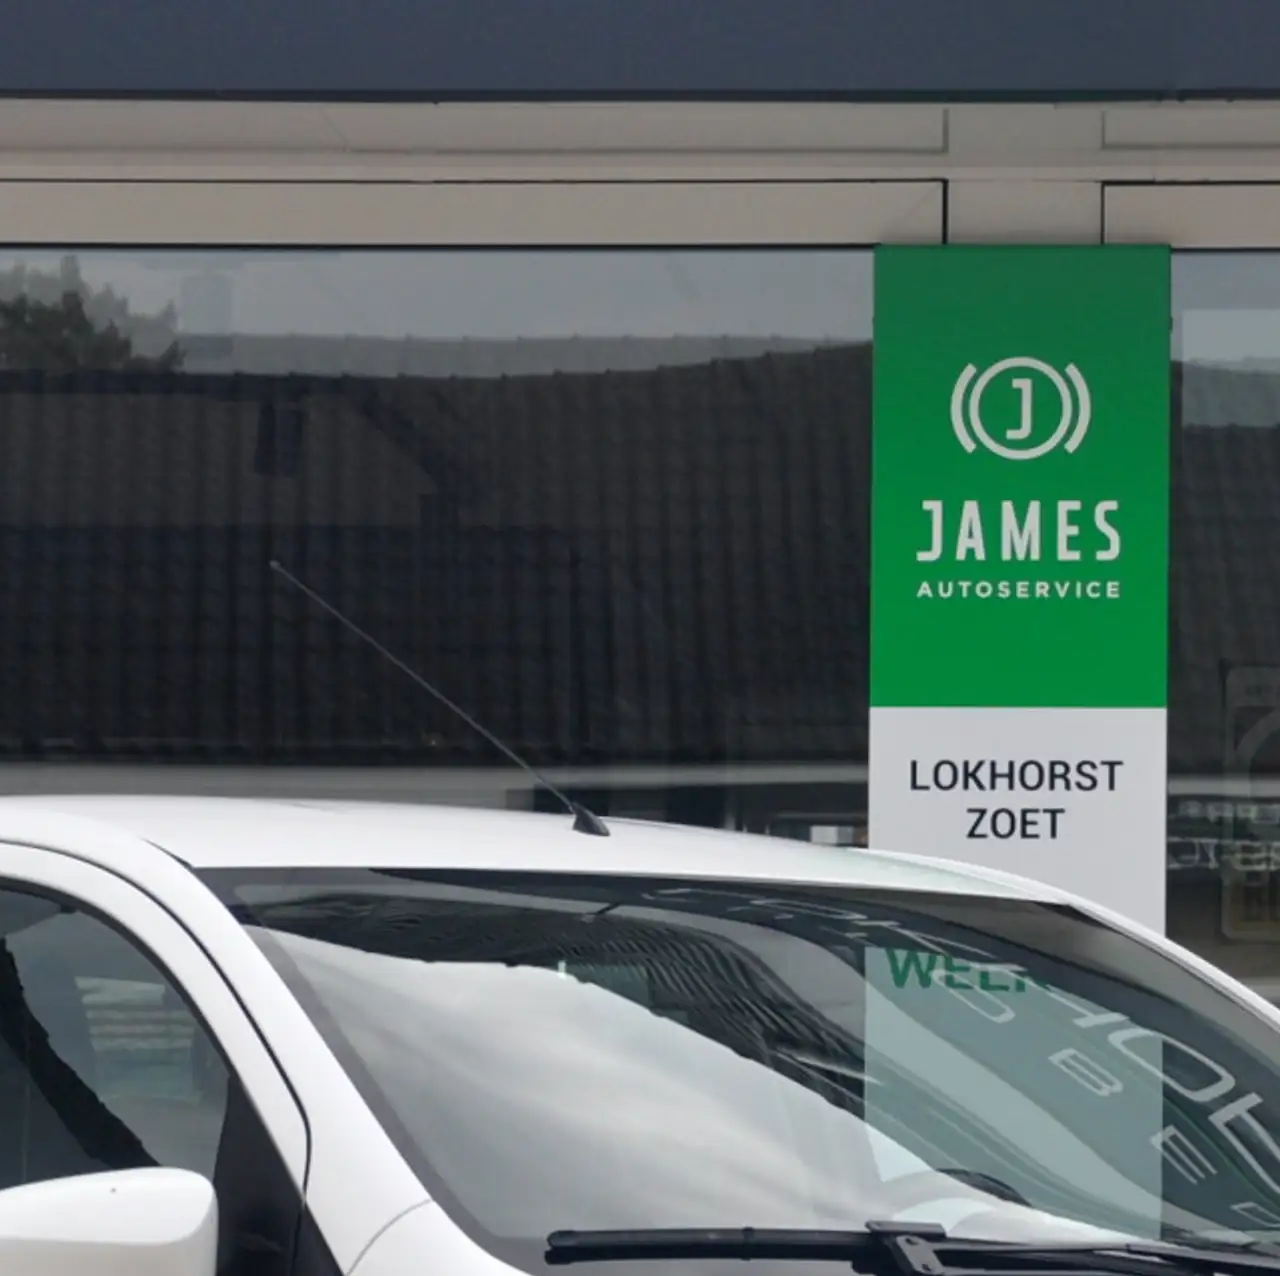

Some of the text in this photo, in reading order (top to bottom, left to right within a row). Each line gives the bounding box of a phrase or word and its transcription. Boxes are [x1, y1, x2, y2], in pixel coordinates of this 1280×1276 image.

[916, 499, 1121, 562] JAMES
[916, 580, 1121, 599] AUTOSERVICE
[910, 759, 1125, 791] LOKHORST
[966, 807, 1066, 839] ZOET
